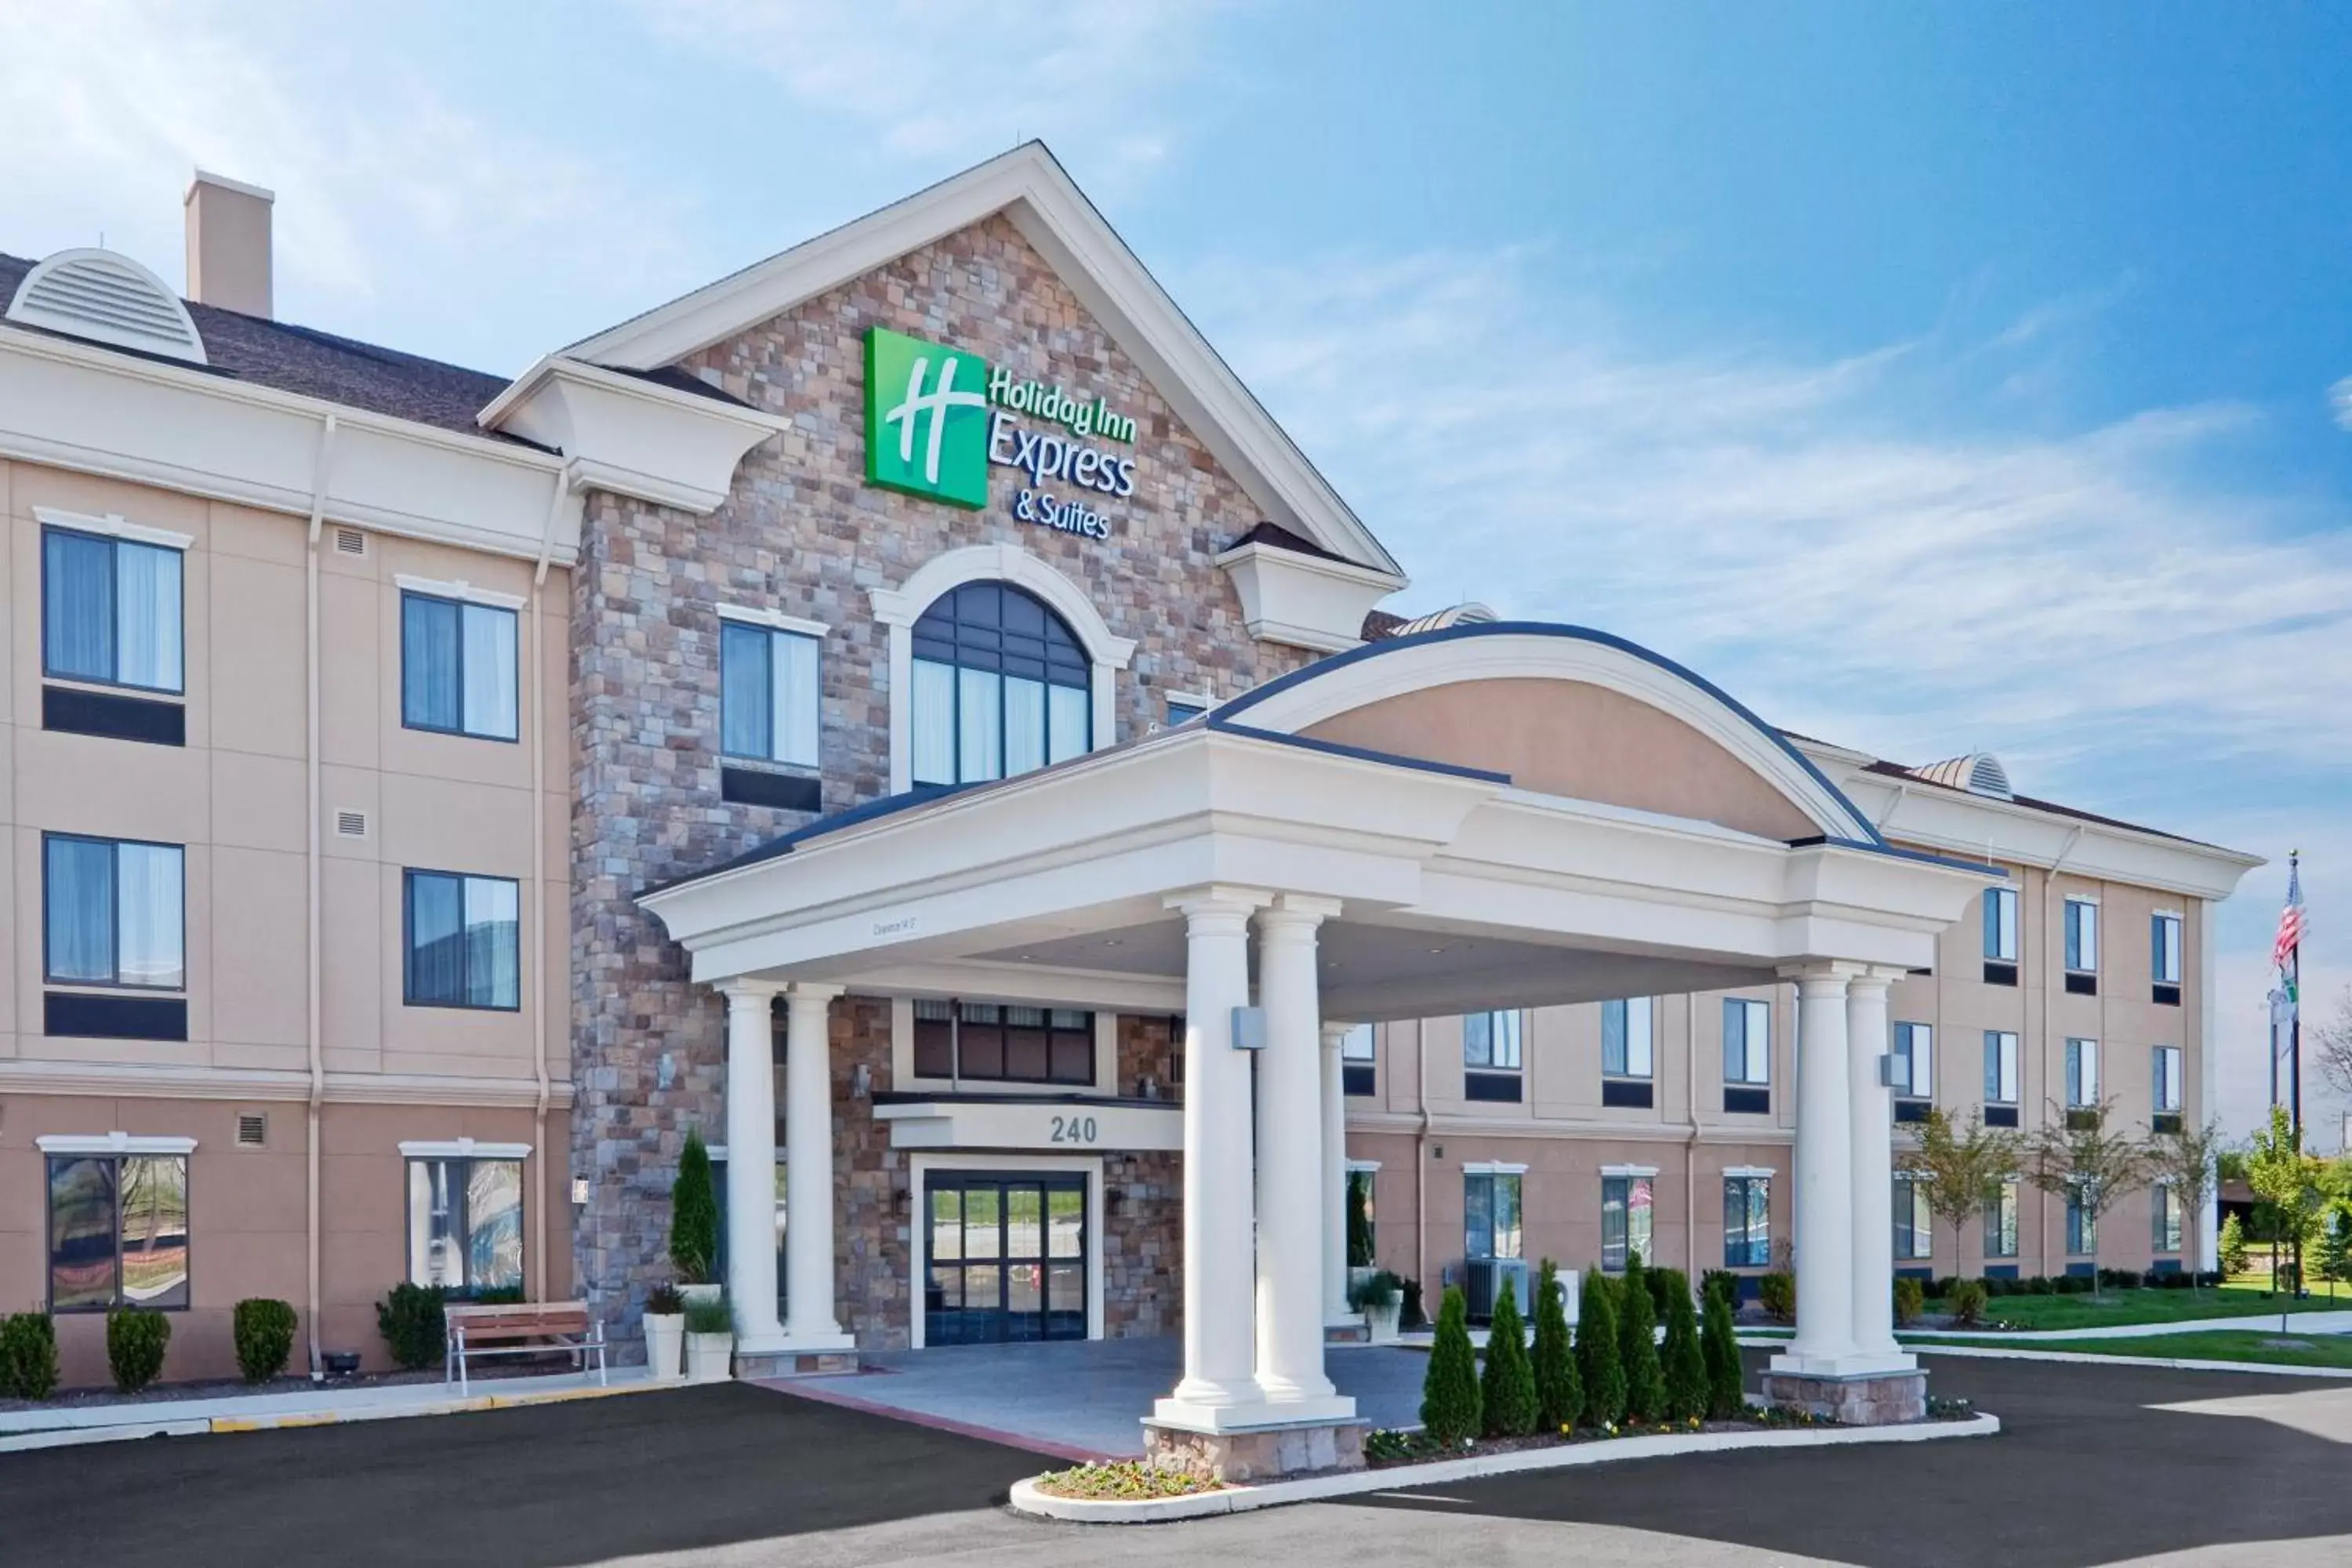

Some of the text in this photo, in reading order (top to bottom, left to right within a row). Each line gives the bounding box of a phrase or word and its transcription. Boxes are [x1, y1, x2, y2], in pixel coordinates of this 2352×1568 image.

[989, 365, 1137, 443] Holiday Inn
[988, 411, 1136, 497] Express
[1016, 488, 1111, 539] & Suites
[1051, 1115, 1097, 1143] 240
